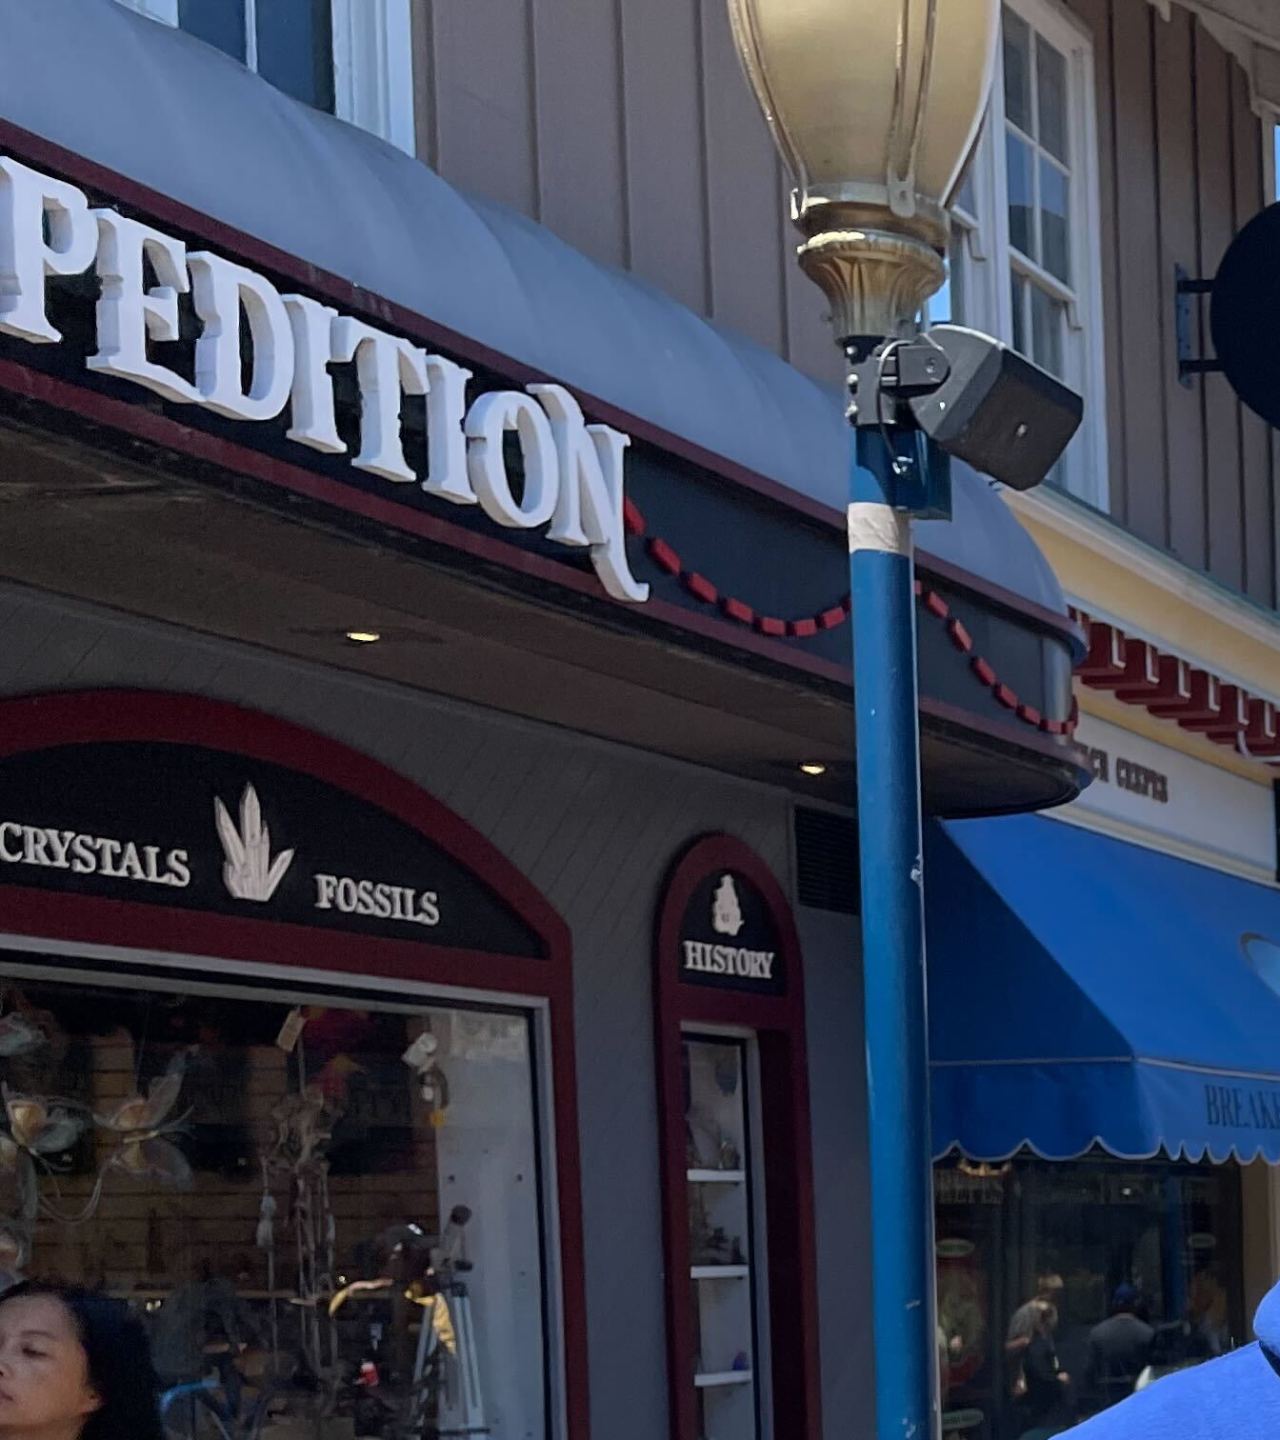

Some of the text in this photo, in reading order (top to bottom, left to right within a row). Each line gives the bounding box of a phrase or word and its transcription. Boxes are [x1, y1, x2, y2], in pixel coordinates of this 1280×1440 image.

[0, 821, 190, 887] CRYSTALS
[314, 873, 440, 926] FOSSILS
[682, 940, 775, 979] HISTORY
